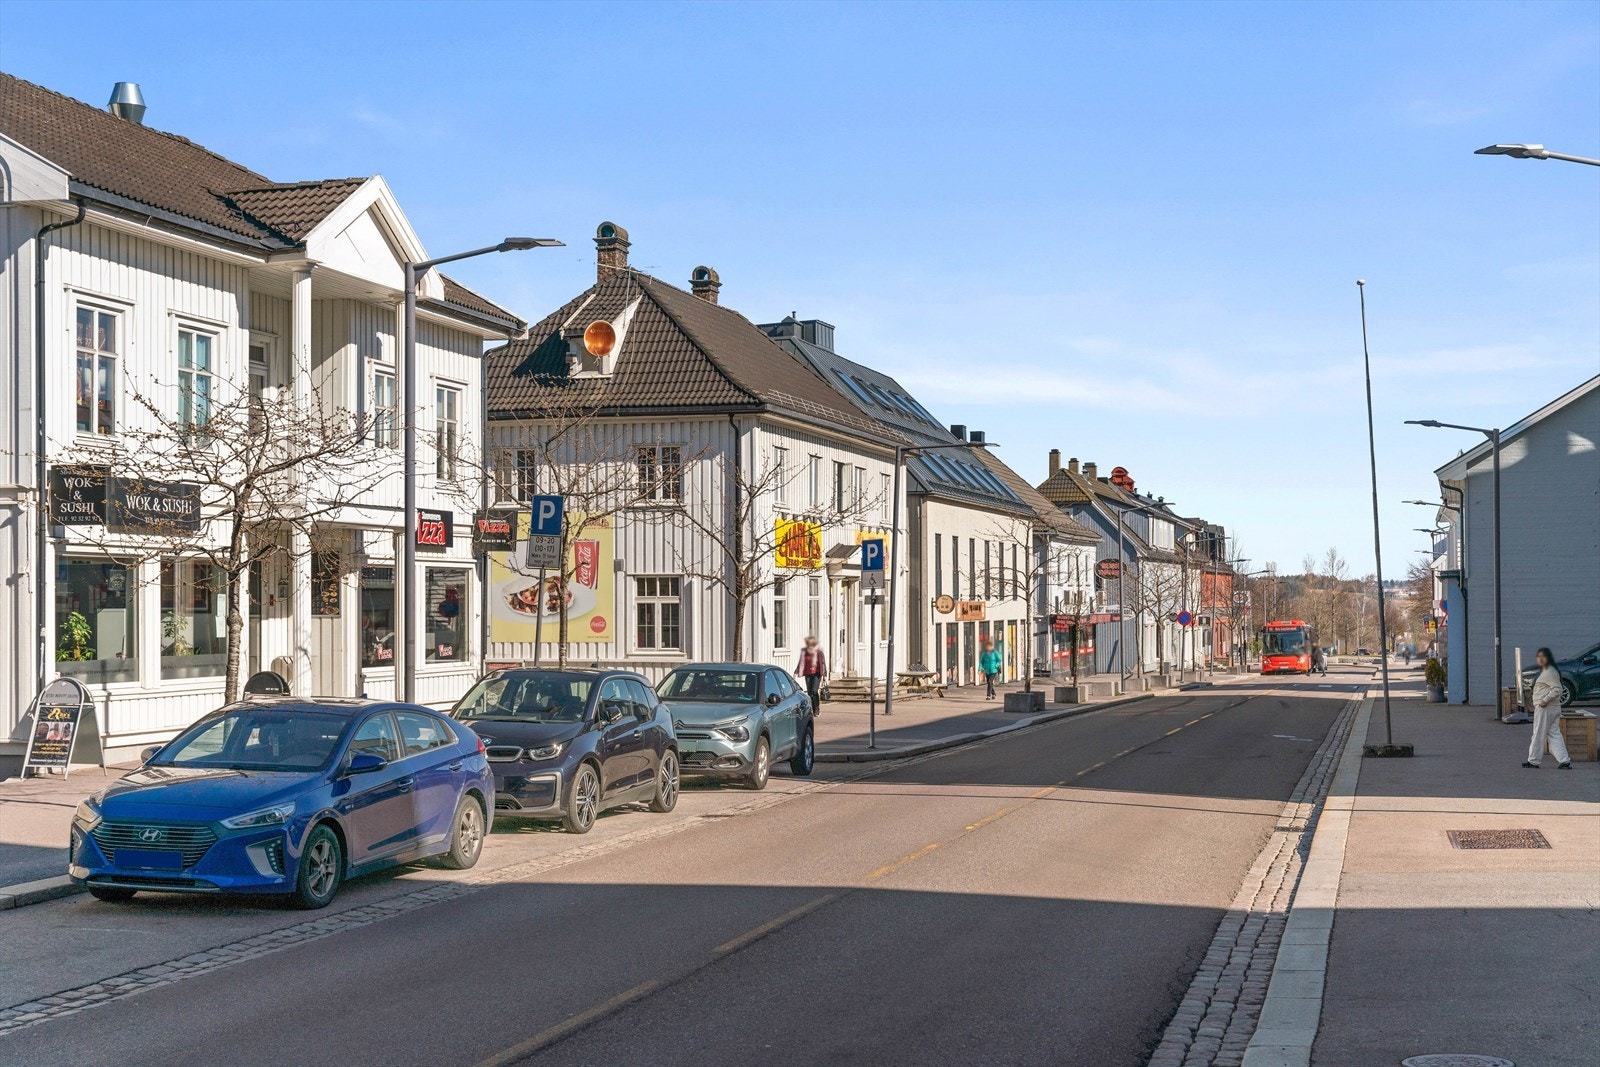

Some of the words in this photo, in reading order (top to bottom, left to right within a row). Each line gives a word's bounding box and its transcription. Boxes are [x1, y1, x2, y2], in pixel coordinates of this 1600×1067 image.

[63, 477, 92, 488] WOK
[73, 490, 82, 500] &
[125, 494, 151, 511] WOK
[153, 498, 161, 512] &
[60, 502, 94, 513] SUSHI
[538, 500, 556, 530] P
[415, 511, 446, 545] izza
[866, 543, 879, 567] P
